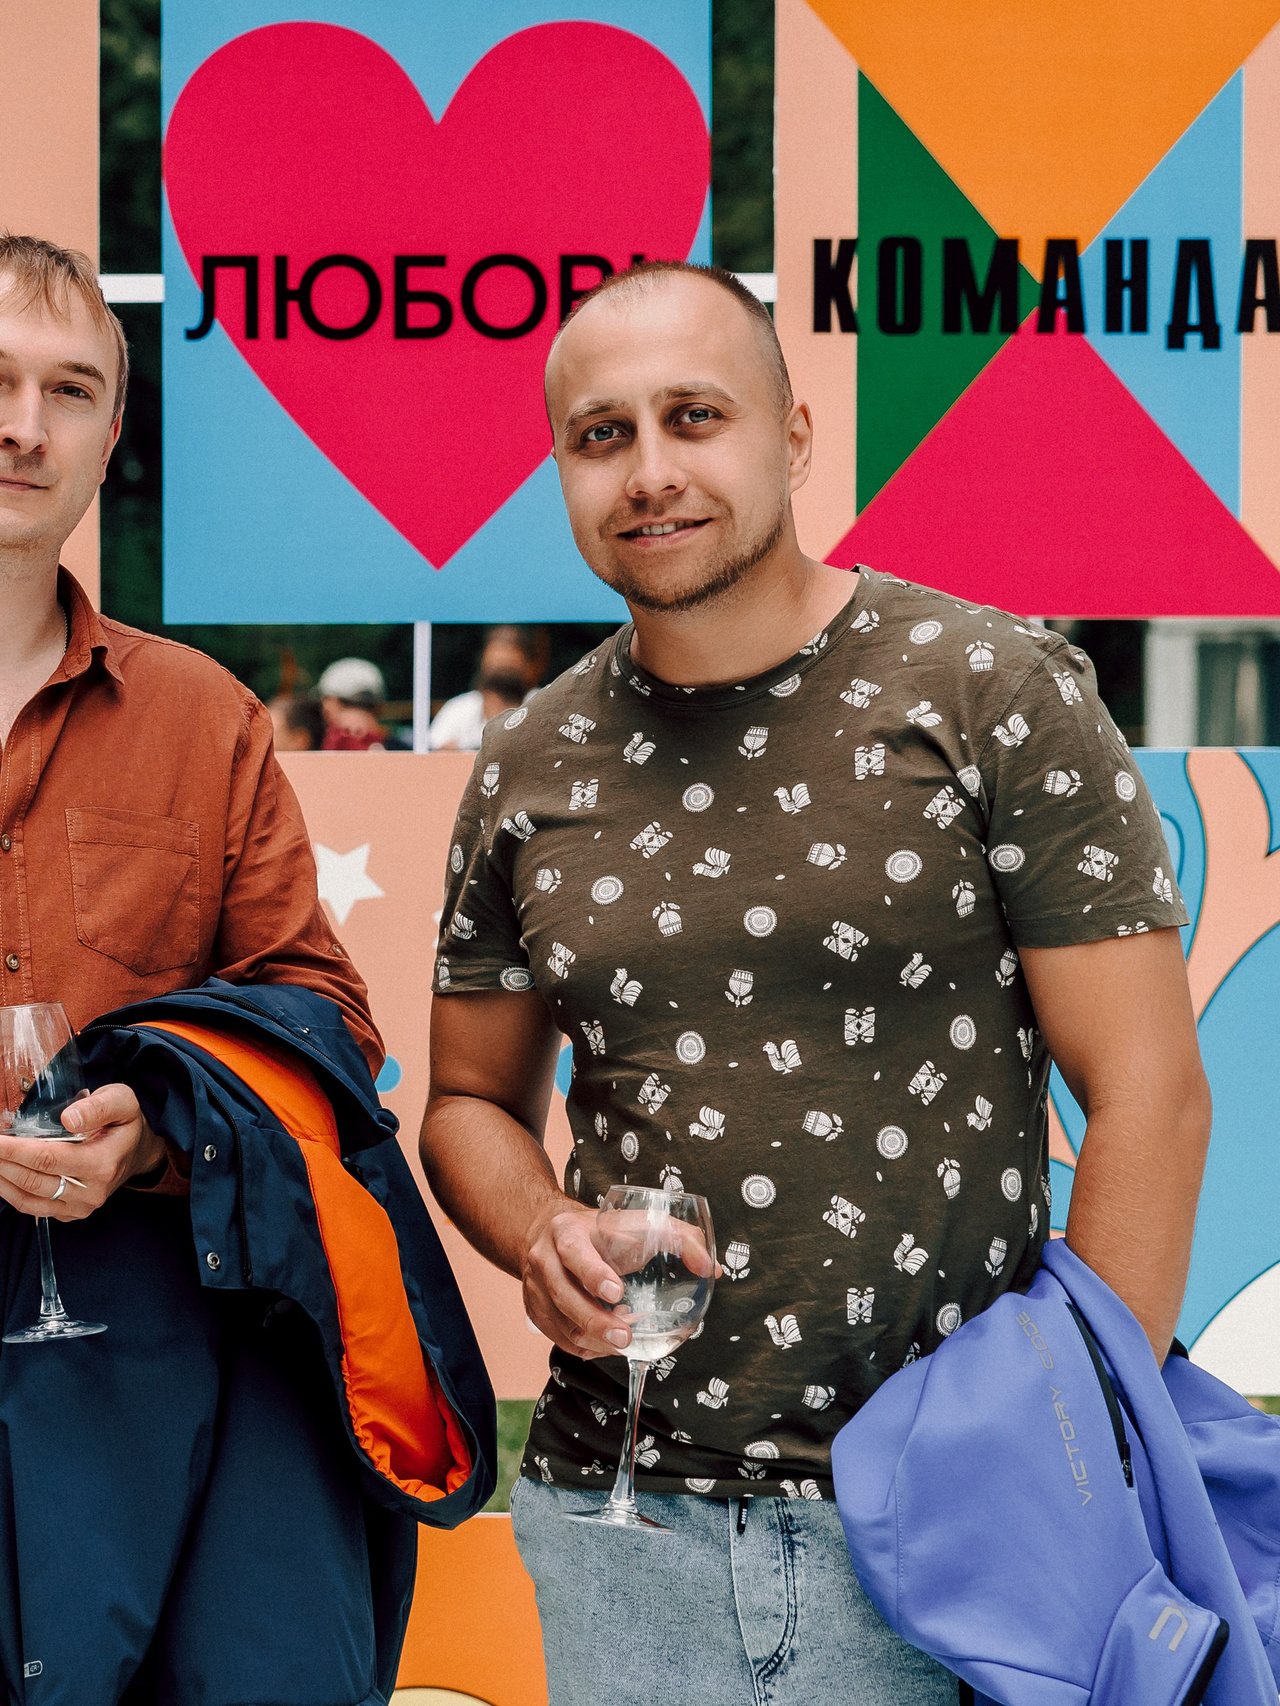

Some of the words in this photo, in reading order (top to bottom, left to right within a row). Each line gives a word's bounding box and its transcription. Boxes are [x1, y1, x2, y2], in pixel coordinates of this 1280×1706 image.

[184, 253, 645, 341] ЛЮБОВ
[812, 236, 1280, 350] КОМАНДА
[1015, 1310, 1055, 1370] CODE
[1049, 1384, 1093, 1507] VICTORY
